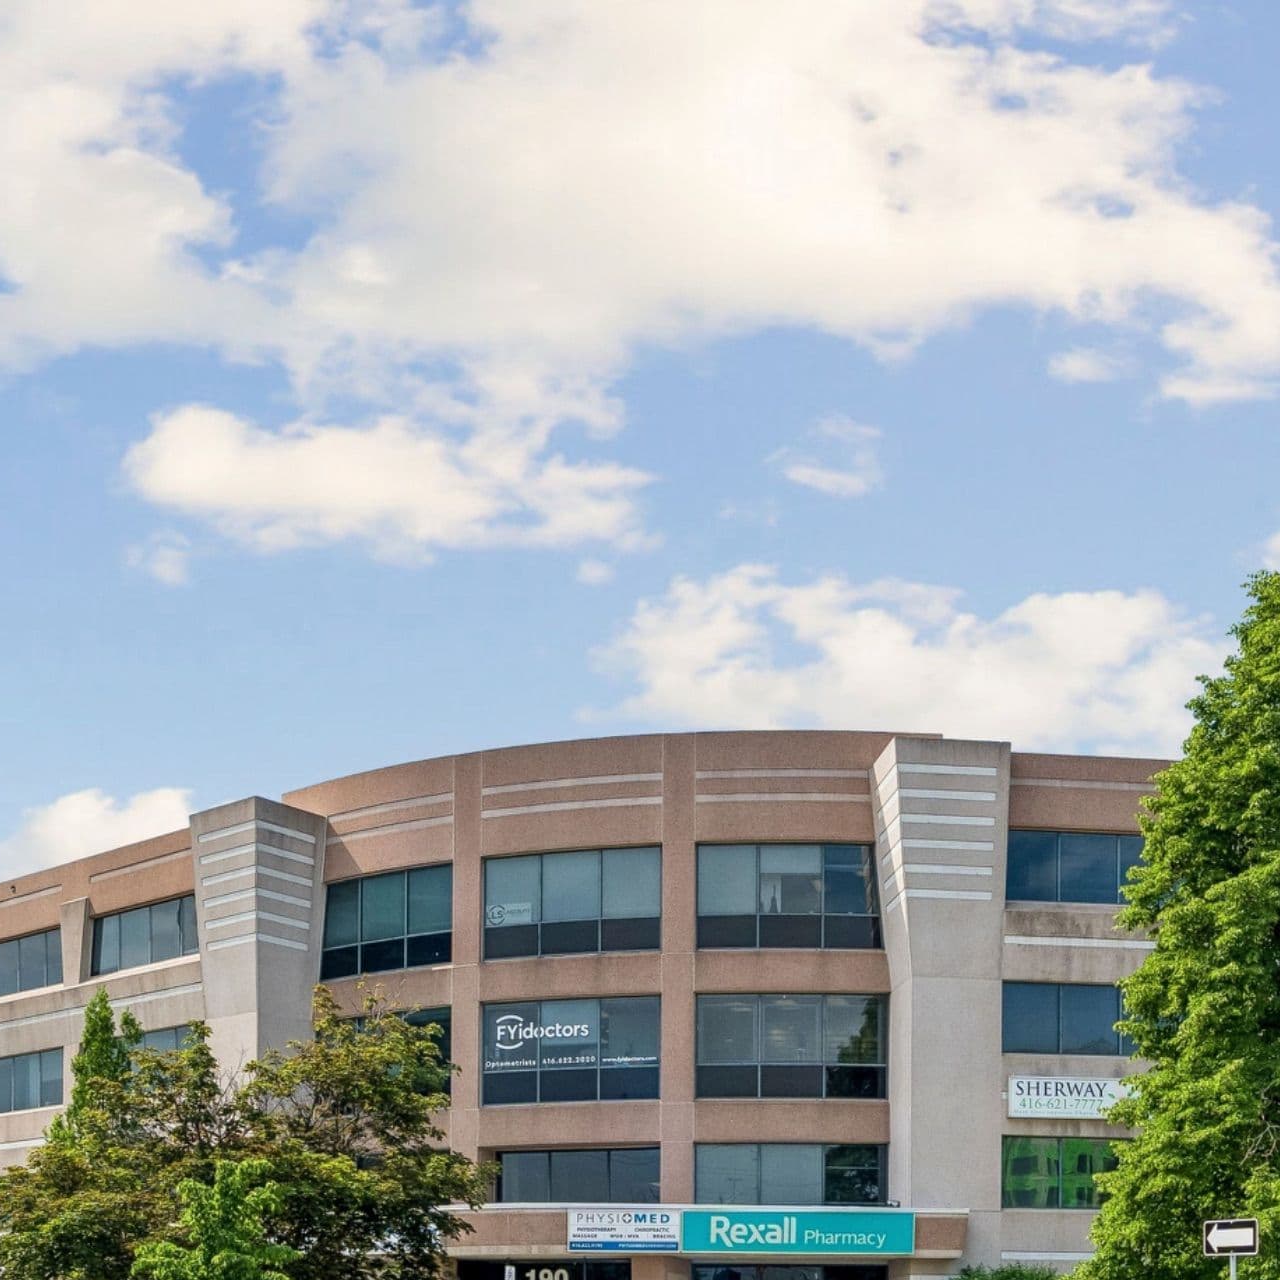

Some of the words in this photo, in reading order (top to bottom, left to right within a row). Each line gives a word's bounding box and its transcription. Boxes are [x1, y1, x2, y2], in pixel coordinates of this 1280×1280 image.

[496, 1022, 589, 1041] FYidoctors
[485, 1059, 536, 1069] Optometrists
[1016, 1080, 1107, 1098] SHERWAY
[1019, 1098, 1104, 1110] 416-621-7777
[577, 1213, 670, 1224] PHYSIOMED
[710, 1216, 797, 1247] Rexall
[804, 1229, 887, 1248] Pharmacy
